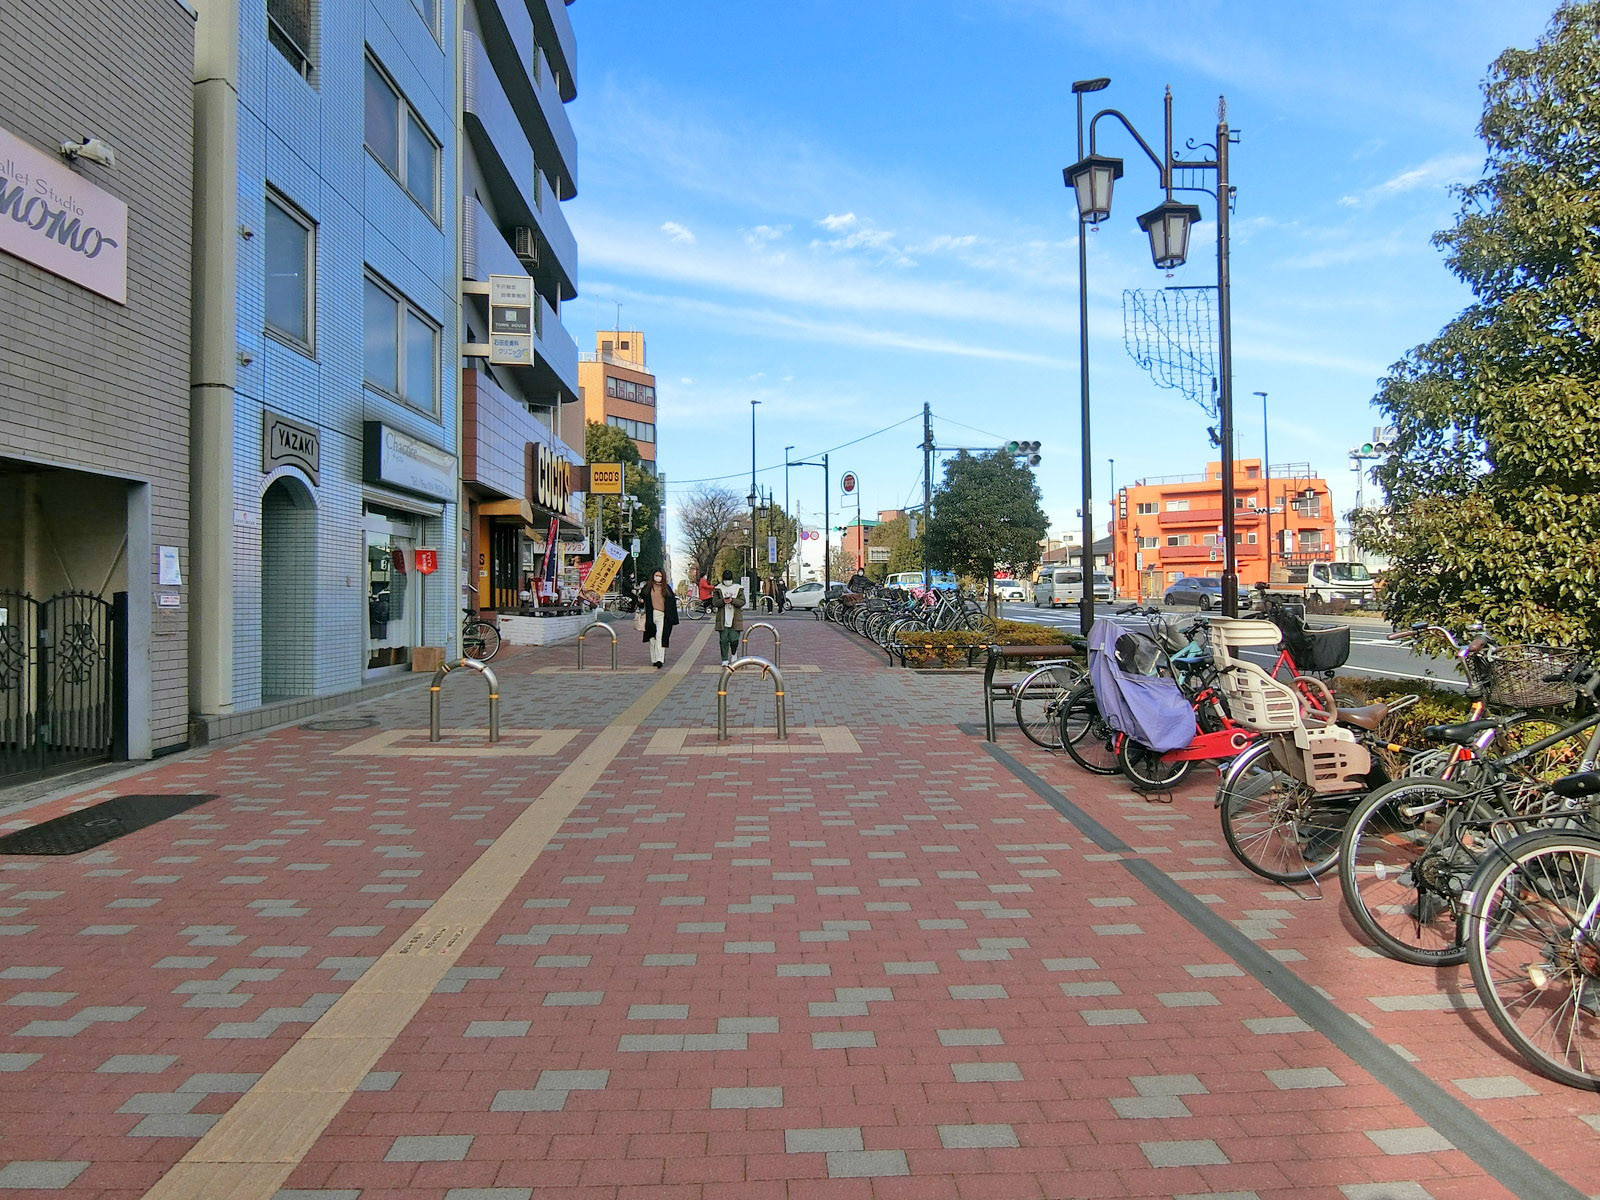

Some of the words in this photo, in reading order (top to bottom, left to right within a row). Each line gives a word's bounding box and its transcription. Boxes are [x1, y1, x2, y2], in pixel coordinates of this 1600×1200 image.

[34, 178, 85, 217] Studio
[498, 348, 521, 356] クリニック
[278, 428, 314, 457] YAZAKI
[593, 471, 620, 482] COCO'S
